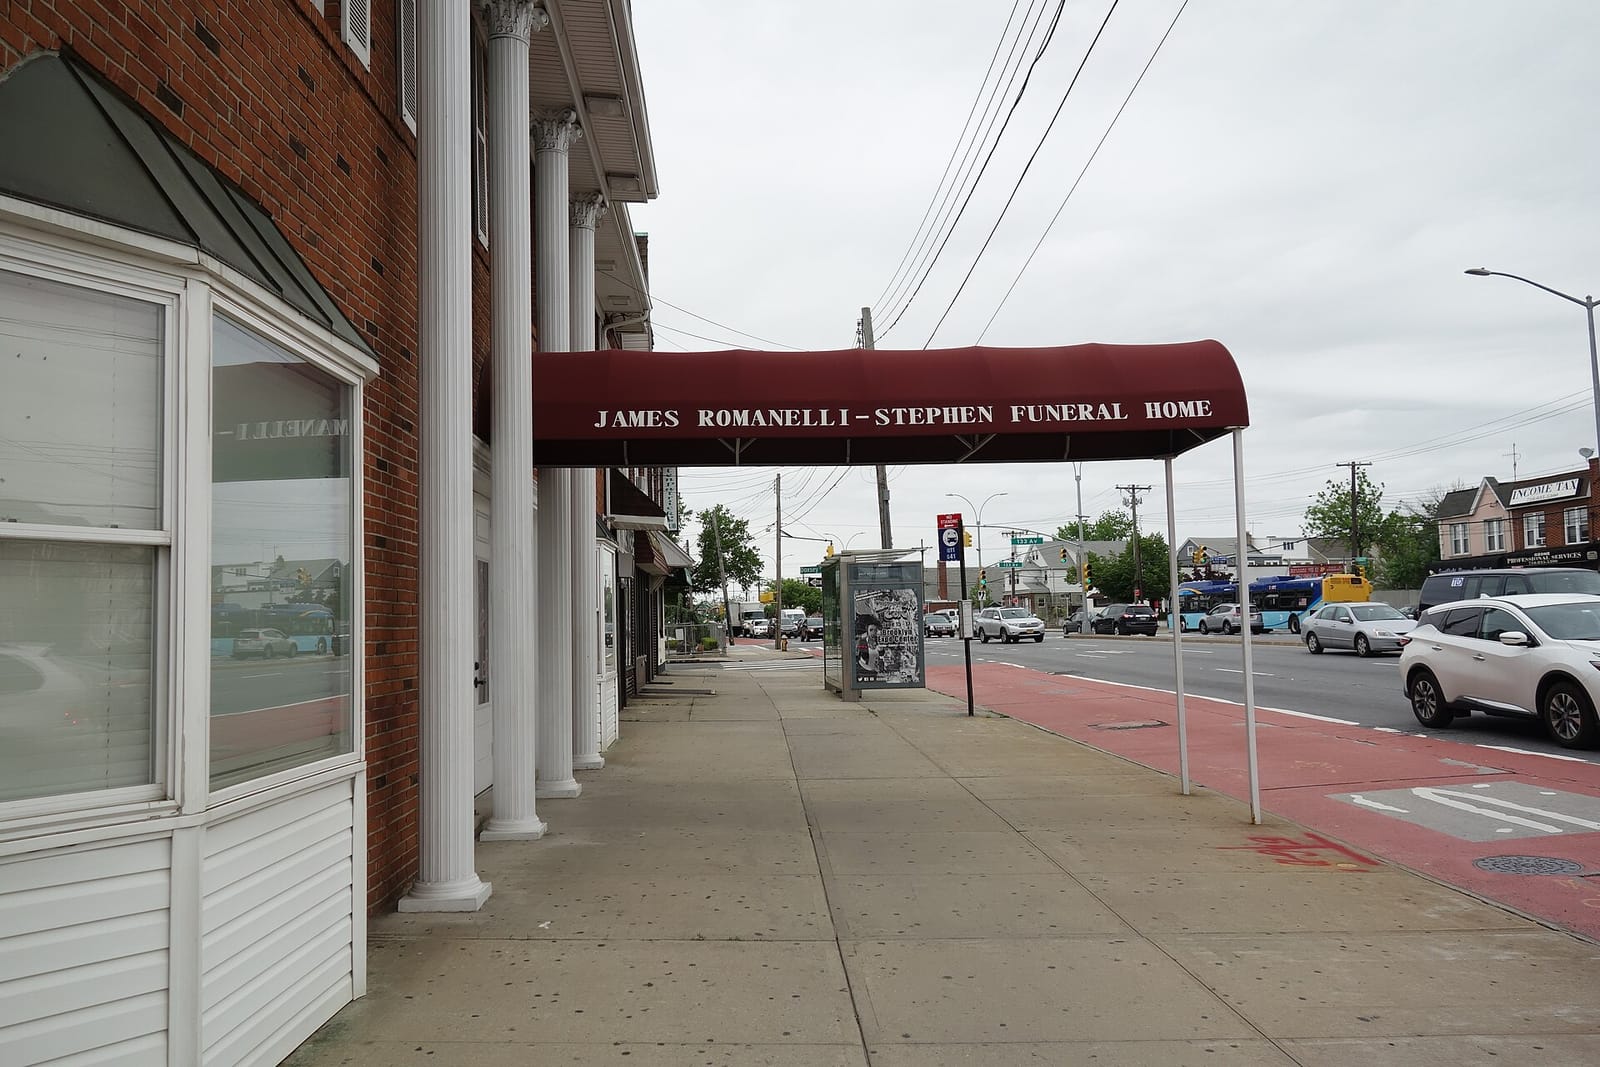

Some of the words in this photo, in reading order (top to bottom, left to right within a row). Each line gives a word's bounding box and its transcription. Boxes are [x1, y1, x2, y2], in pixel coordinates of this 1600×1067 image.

[594, 410, 680, 428] JAMES
[1010, 402, 1128, 422] FUNERAL
[1144, 400, 1212, 420] HOME
[1512, 485, 1552, 500] INCOME
[1556, 480, 1577, 492] TAX
[1507, 555, 1549, 565] PROFESSIONAL
[1551, 552, 1582, 560] SERVICES
[878, 635, 895, 643] Expo
[882, 628, 913, 637] Brooklyn
